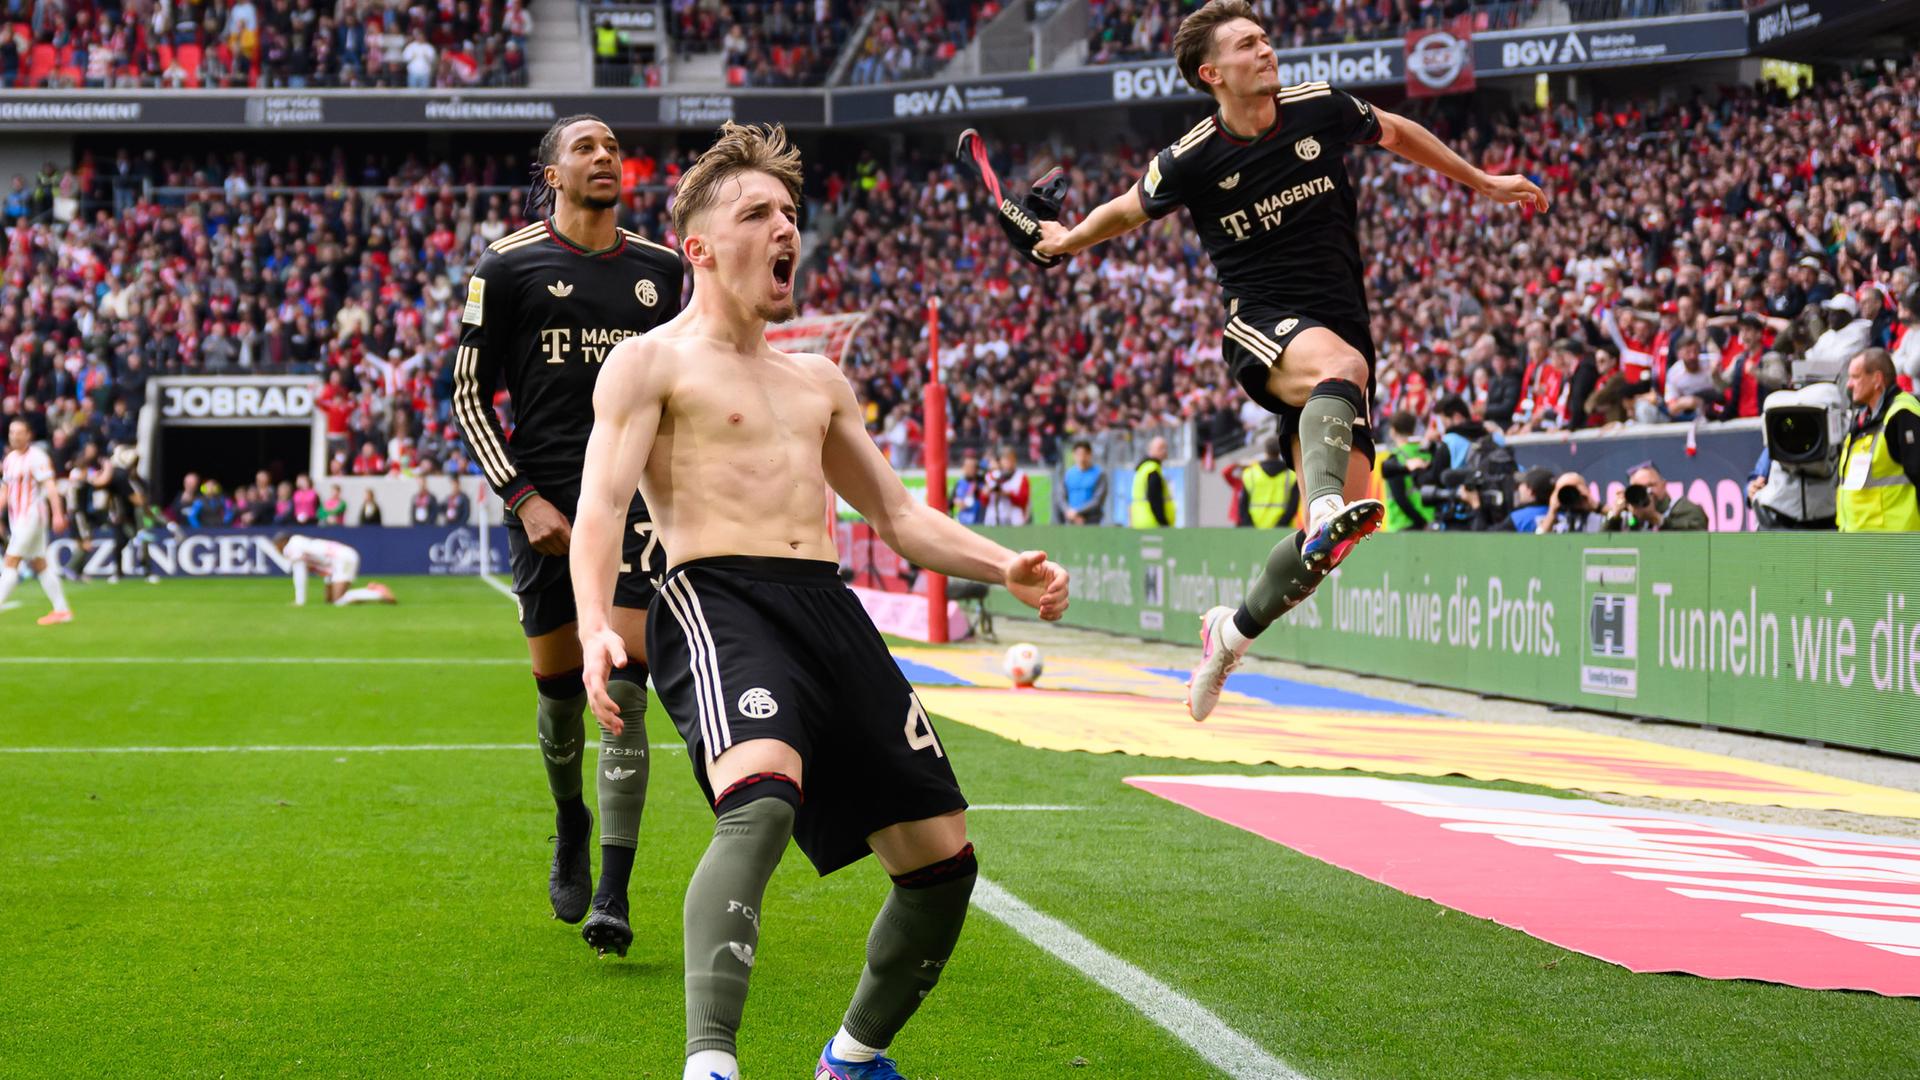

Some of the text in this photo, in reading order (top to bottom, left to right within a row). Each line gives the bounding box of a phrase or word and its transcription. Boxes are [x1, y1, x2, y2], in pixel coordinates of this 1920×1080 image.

[1502, 38, 1558, 67] BGV
[1254, 176, 1335, 216] MAGENTA
[1260, 211, 1282, 231] TV
[582, 347, 605, 363] TV
[162, 386, 312, 417] JOBRAD
[1330, 568, 1400, 638] Tunneln
[1406, 574, 1441, 644] wie
[1448, 576, 1480, 649] die
[1488, 577, 1560, 657] Profis.
[1653, 583, 1778, 678] Tunneln
[1791, 590, 1856, 688] wie
[604, 747, 645, 757] FCBM
